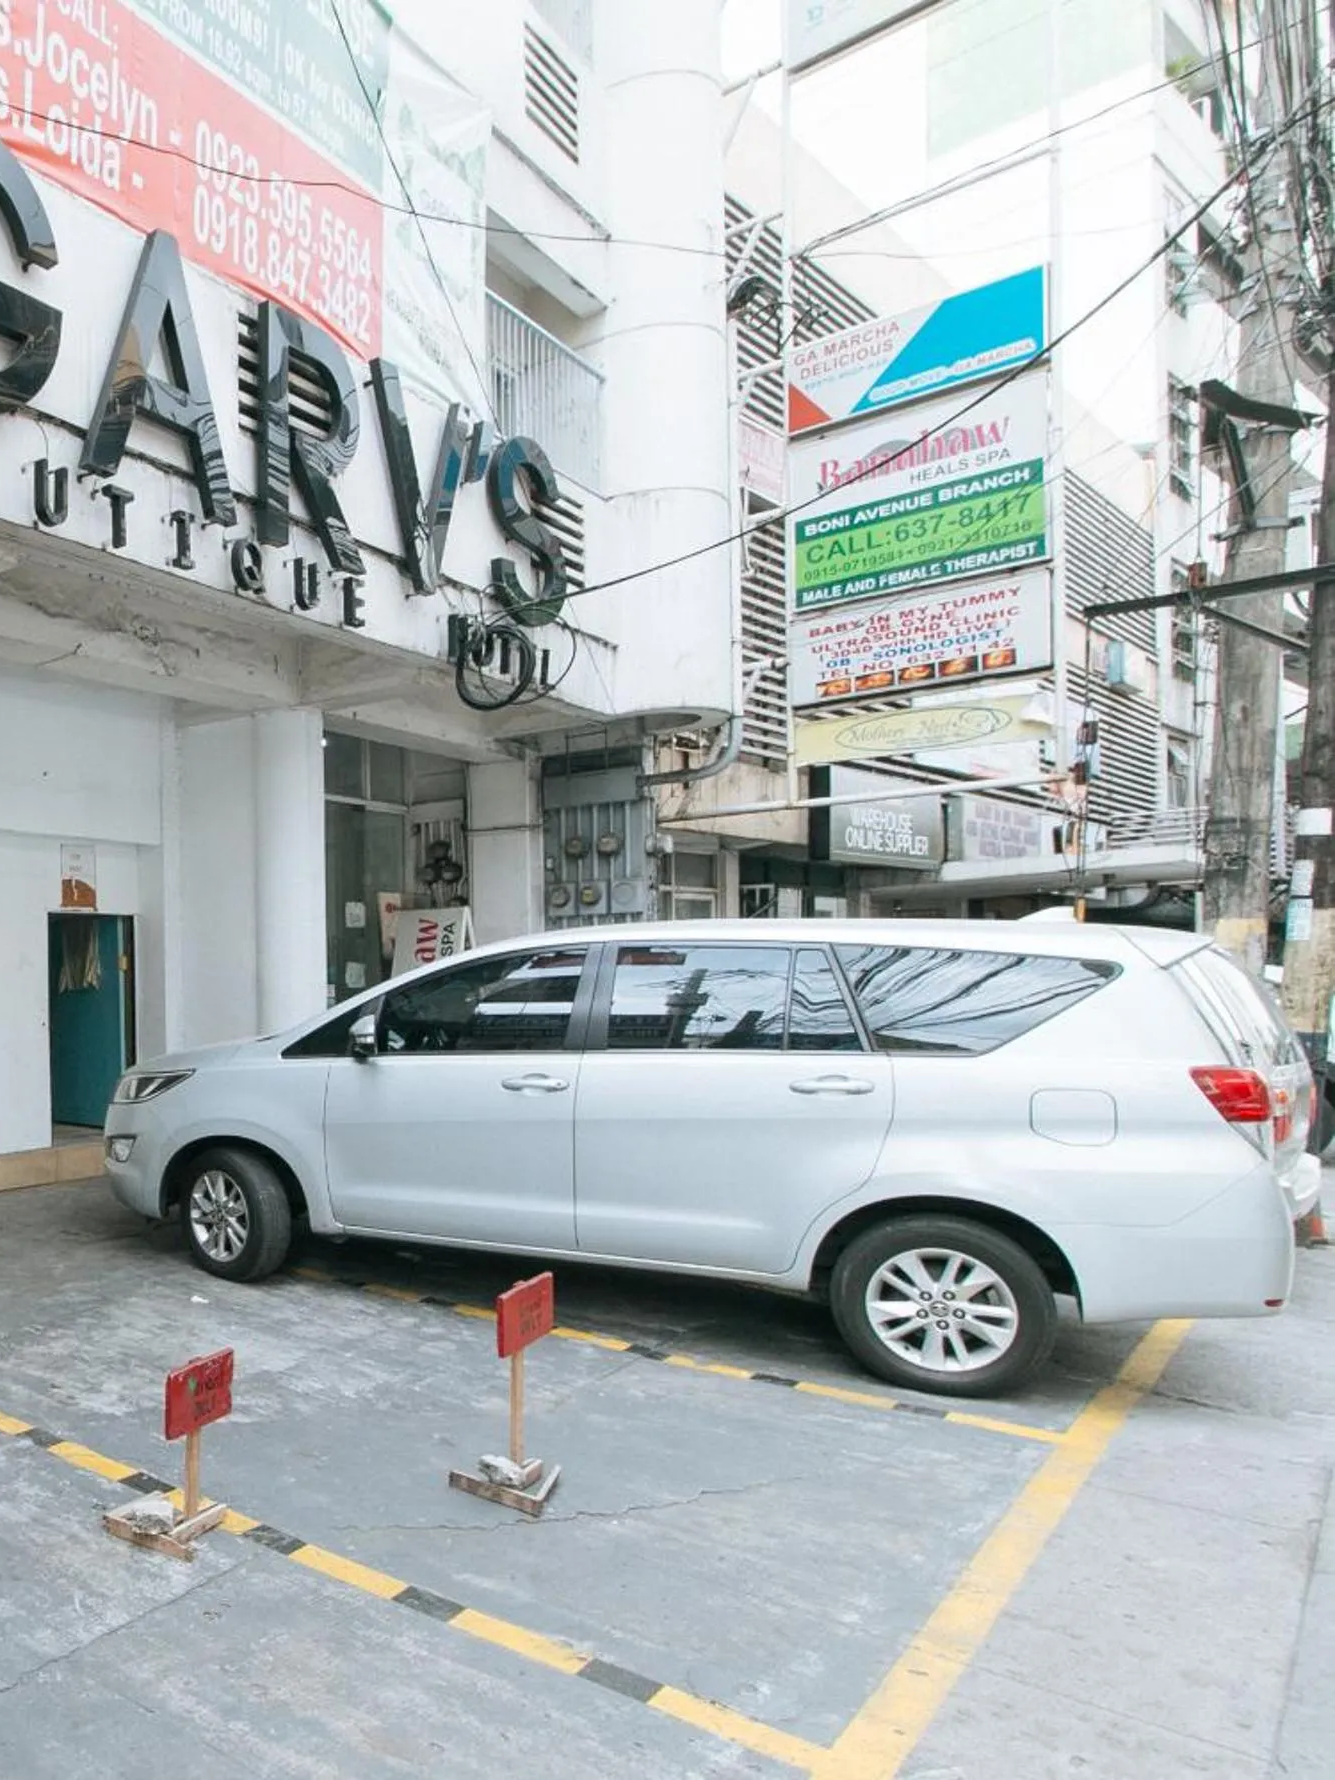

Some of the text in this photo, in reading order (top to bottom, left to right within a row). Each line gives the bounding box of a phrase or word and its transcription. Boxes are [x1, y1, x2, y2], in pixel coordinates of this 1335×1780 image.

[195, 119, 373, 288] 0923.595.5564
[193, 183, 372, 345] 0918.847.3482
[793, 321, 900, 367] GA MARCHA
[800, 339, 894, 380] DELICIOUS
[973, 447, 1012, 468] SPA
[804, 466, 1031, 537] BONI AVENUE BRANCH
[802, 540, 1039, 605] MALE AND FEMALE THERAPIST
[808, 585, 1023, 639] BABY IN MY TUMMY
[811, 605, 1021, 654] ULTRASOUND CLINIC
[864, 623, 891, 636] OB
[953, 620, 994, 638] LIVE
[825, 657, 852, 669] OB
[873, 629, 1005, 661] SONOLOGIST
[818, 668, 855, 681] TEL
[845, 825, 884, 852] ONLINE
[440, 919, 458, 957] SPA
